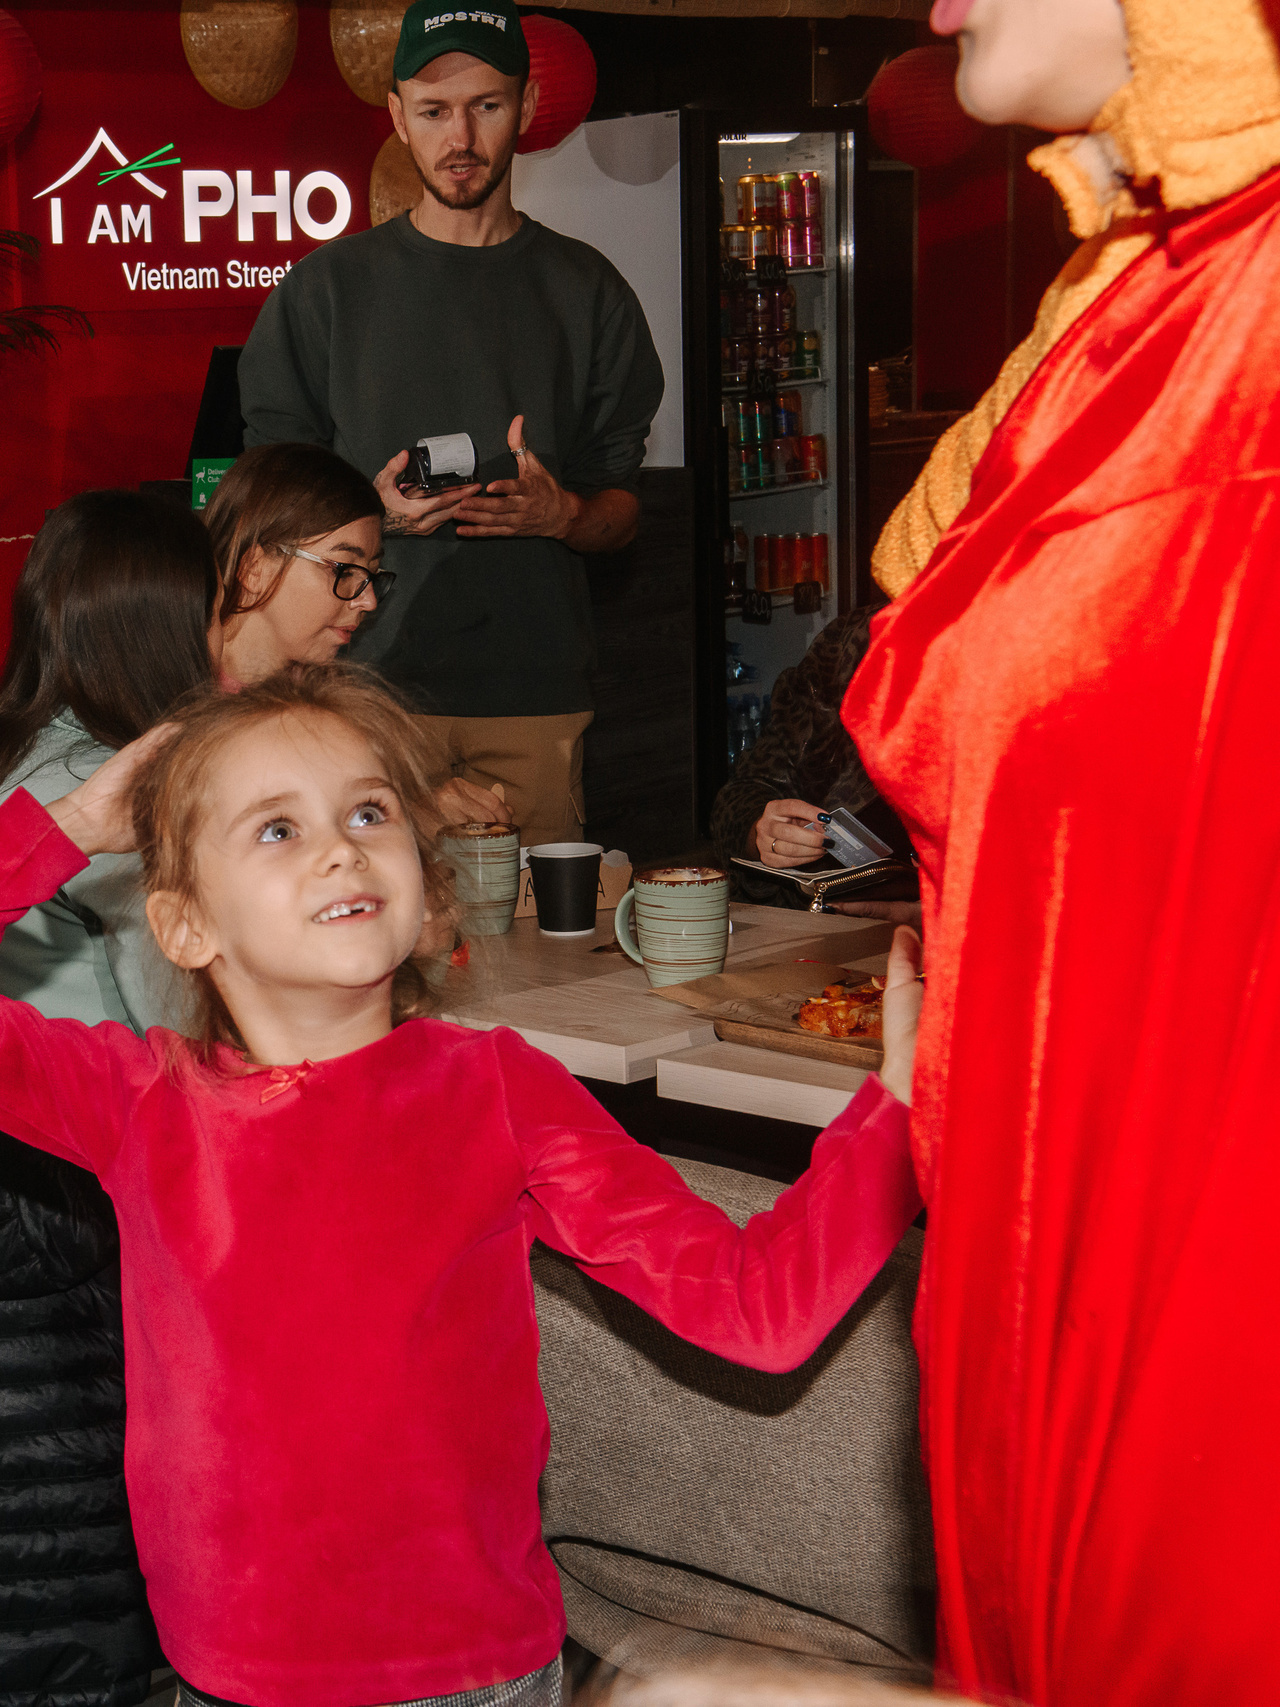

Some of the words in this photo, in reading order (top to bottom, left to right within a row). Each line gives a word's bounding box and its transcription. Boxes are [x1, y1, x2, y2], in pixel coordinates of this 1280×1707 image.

[424, 11, 506, 32] MOSTRA
[50, 197, 63, 244] I
[87, 204, 152, 244] AM
[182, 170, 352, 242] PHO
[122, 261, 219, 291] Vietnam
